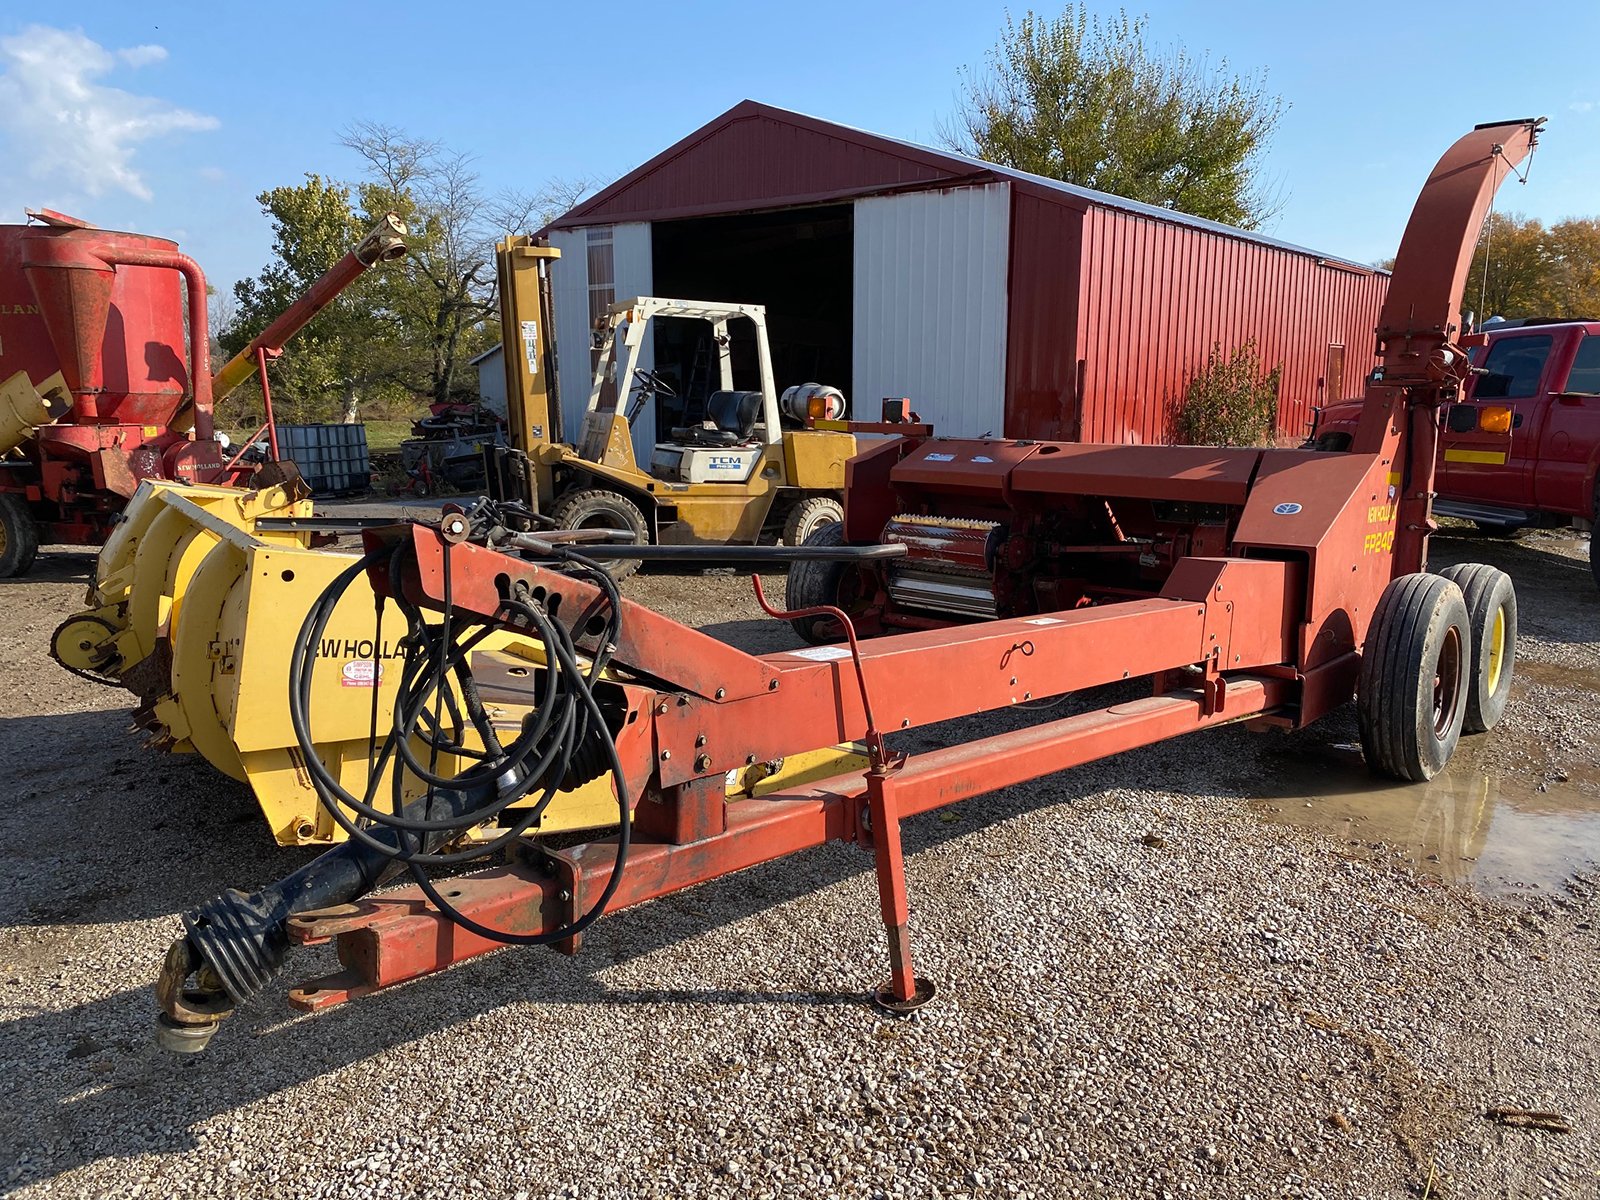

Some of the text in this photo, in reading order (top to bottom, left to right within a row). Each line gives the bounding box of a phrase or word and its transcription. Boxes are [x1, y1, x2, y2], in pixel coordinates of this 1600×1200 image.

[709, 456, 741, 464] TCM
[1368, 504, 1396, 523] NEW HOLL
[1363, 530, 1394, 556] FP240
[343, 639, 408, 659] HOLLA
